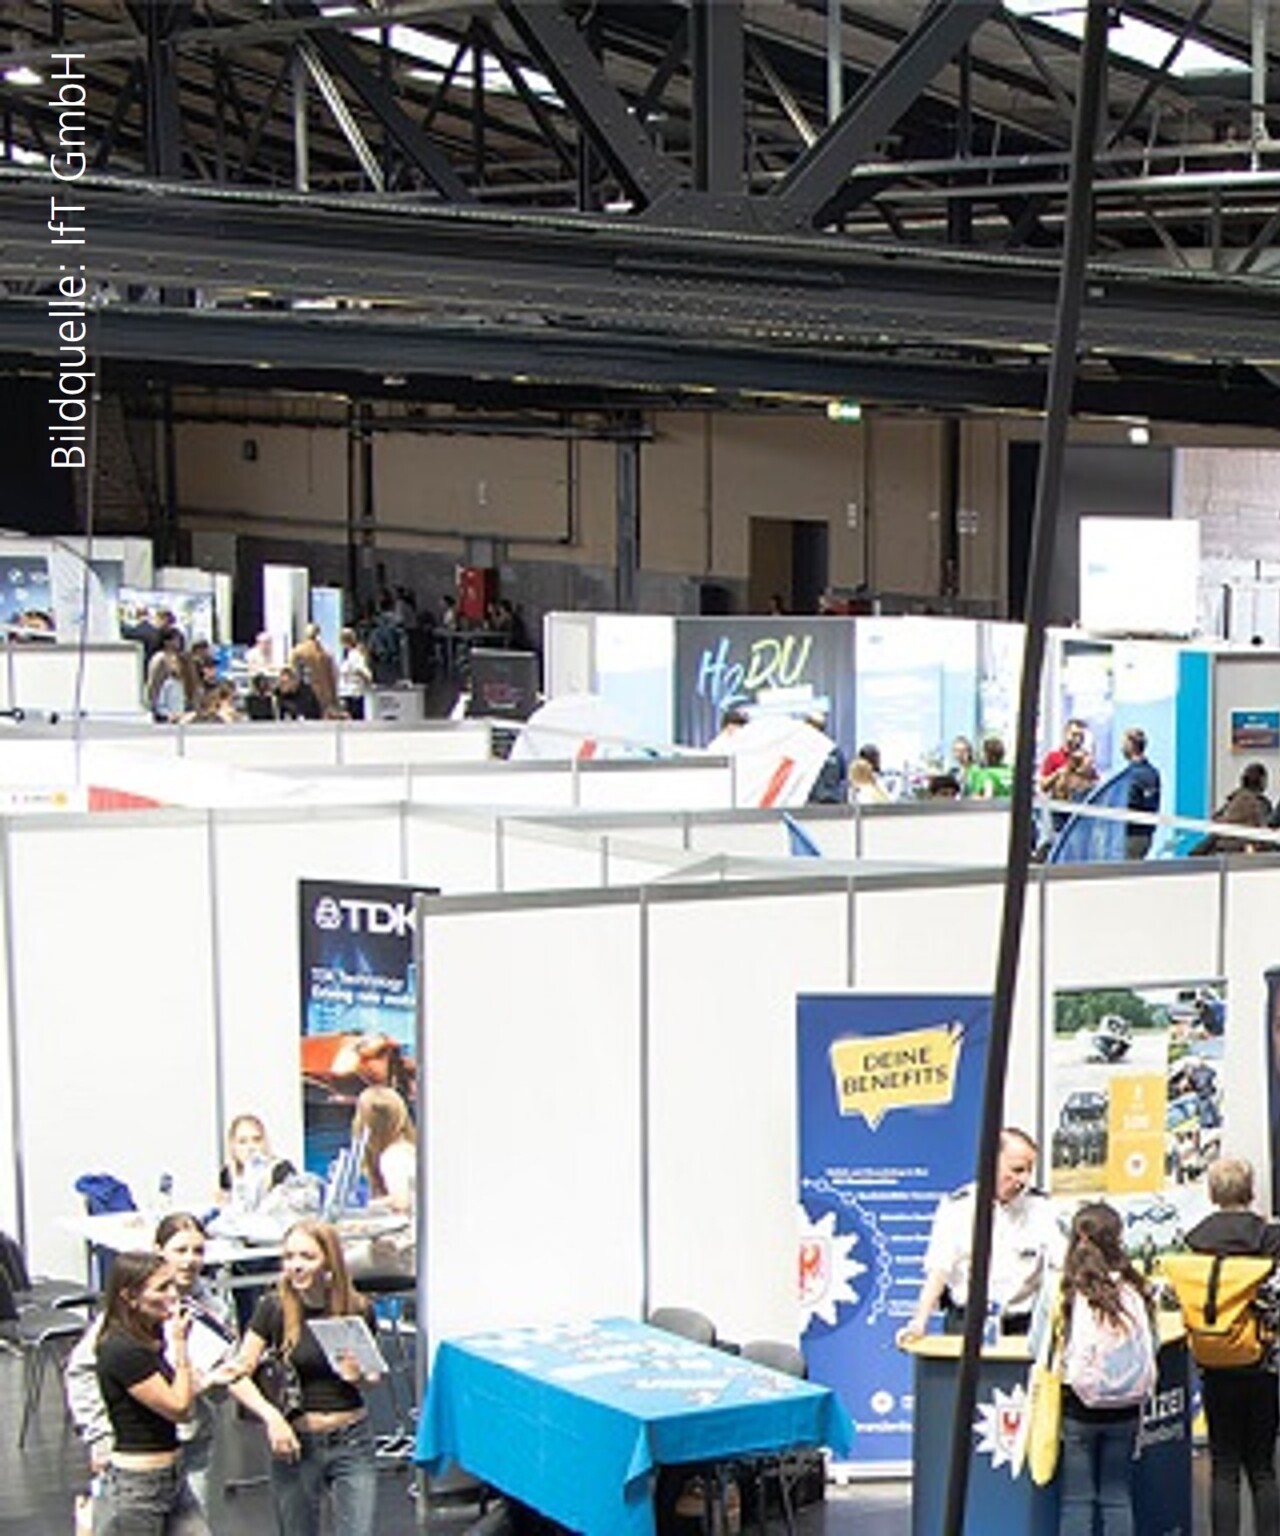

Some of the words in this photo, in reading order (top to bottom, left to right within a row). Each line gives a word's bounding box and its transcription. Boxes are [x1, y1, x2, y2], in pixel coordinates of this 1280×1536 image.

[340, 899, 417, 936] TDK
[863, 1047, 930, 1072] DEINE
[843, 1064, 949, 1096] BENEFITS
